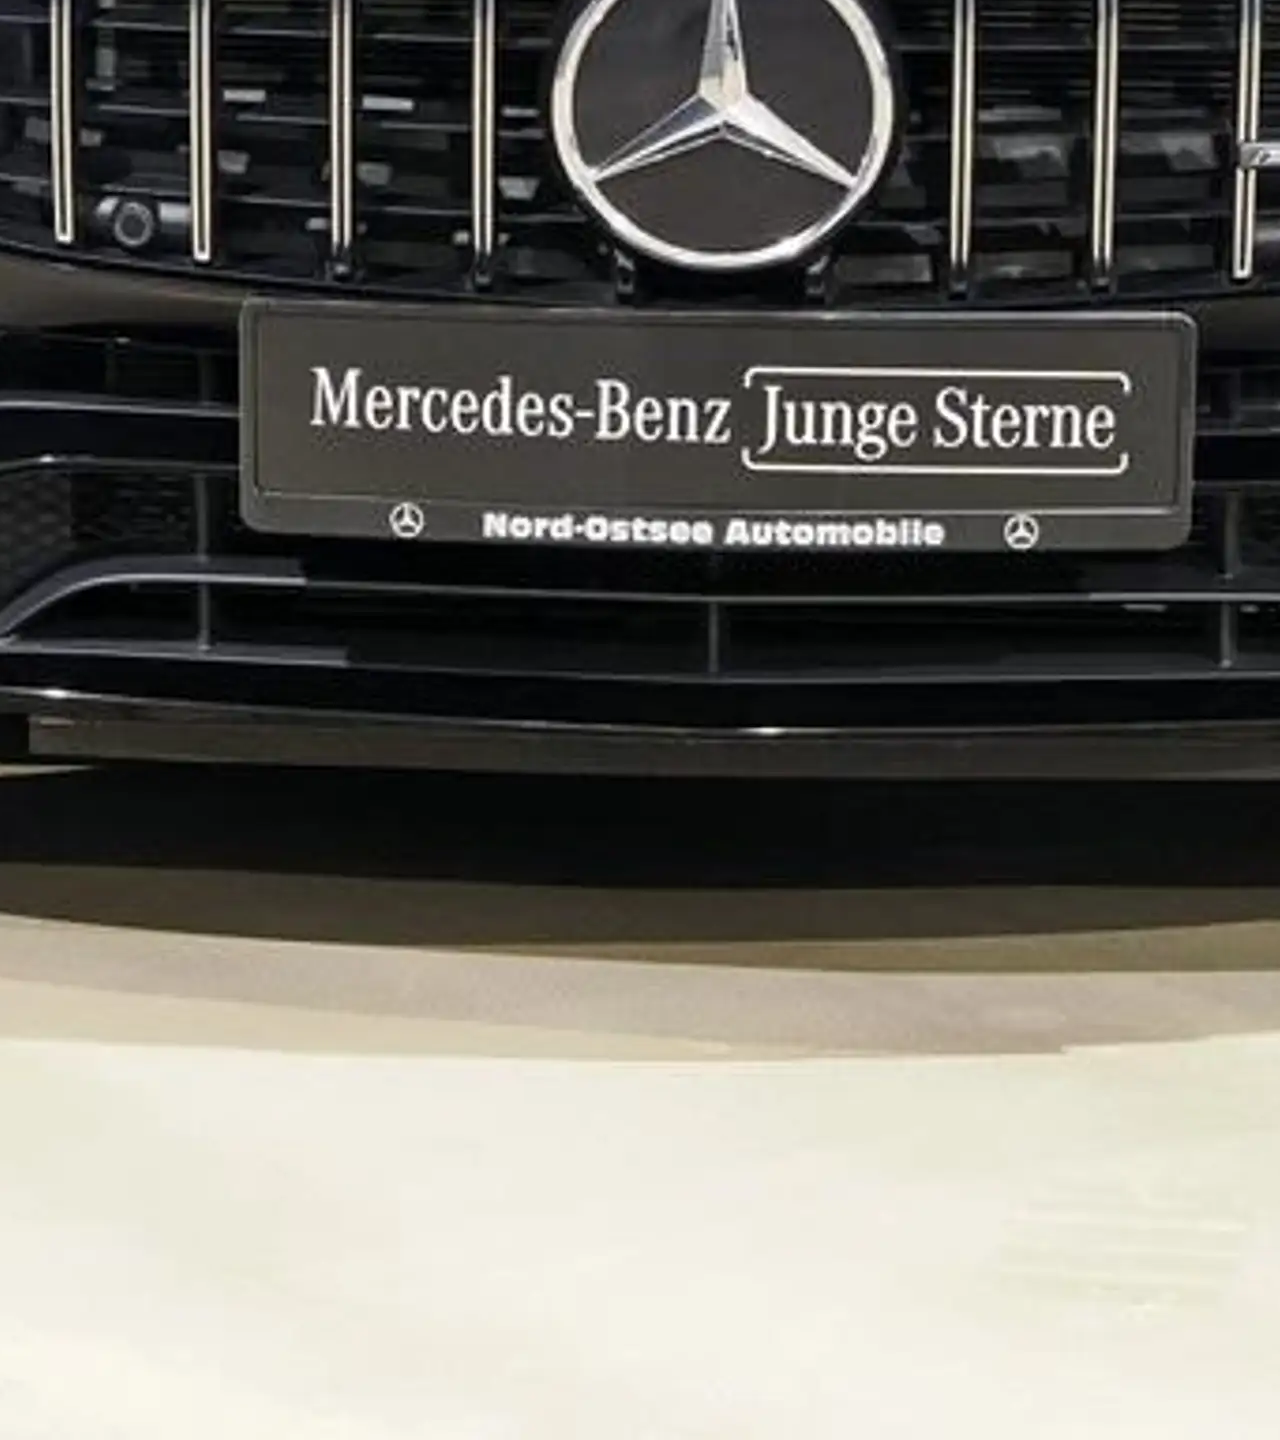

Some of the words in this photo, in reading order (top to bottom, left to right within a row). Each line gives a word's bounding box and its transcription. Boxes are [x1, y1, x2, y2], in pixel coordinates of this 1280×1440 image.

[310, 366, 732, 443] Mercedes-Benz
[757, 385, 919, 461] Junge
[933, 387, 1116, 450] Sterne
[482, 512, 713, 545] Nord-Ostsee
[724, 517, 946, 548] Automobile
